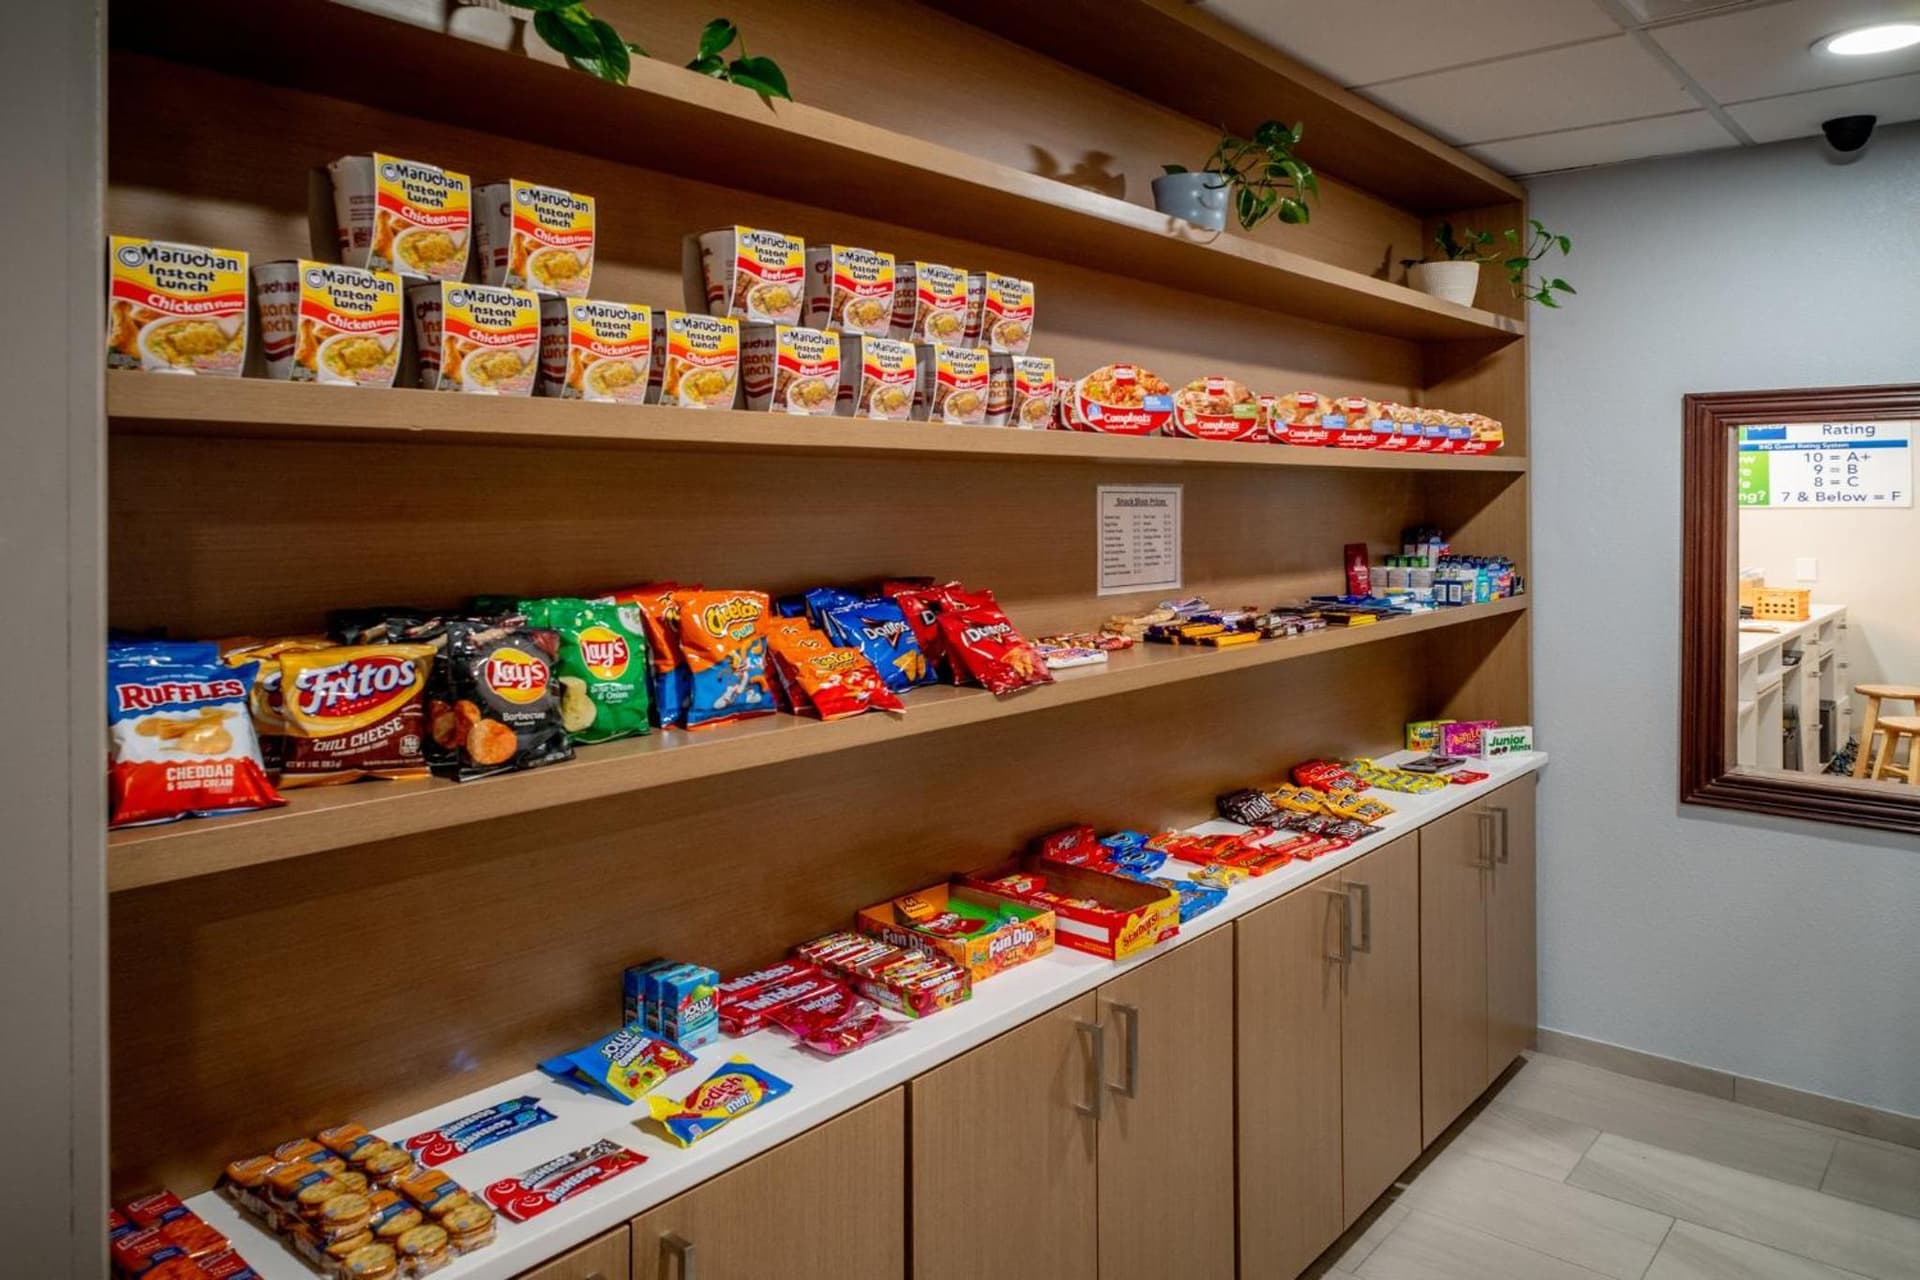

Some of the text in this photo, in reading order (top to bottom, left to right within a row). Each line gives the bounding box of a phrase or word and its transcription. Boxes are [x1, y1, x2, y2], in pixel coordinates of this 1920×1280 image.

[396, 164, 463, 191] Maruchan
[402, 180, 448, 198] Instant
[407, 191, 444, 208] Lunch
[529, 189, 588, 212] Maruchan
[401, 206, 447, 225] Chicken
[534, 204, 575, 220] Instant
[539, 214, 571, 228] Lunch
[535, 228, 574, 244] Chicken
[751, 234, 800, 251] Maruchan
[141, 247, 238, 271] Maruchan
[759, 255, 785, 266] Lunch
[845, 252, 890, 267] Maruchan
[149, 265, 215, 281] Instant
[322, 269, 394, 293] Maruchan
[853, 271, 877, 281] Lunch
[156, 278, 208, 292] Lunch
[328, 286, 378, 302] Instant
[464, 289, 532, 308] Maruchan
[148, 294, 213, 313] Chicken
[333, 298, 372, 312] Lunch
[469, 304, 516, 317] Instant
[327, 313, 376, 330] Chicken
[475, 315, 512, 327] Lunch
[586, 306, 645, 321] Maruchan
[591, 319, 631, 330] Instant
[683, 318, 734, 334] Maruchan
[469, 329, 515, 344] Chicken
[596, 329, 628, 339] Lunch
[687, 331, 722, 342] Instant
[790, 332, 835, 345] Maruchan
[591, 341, 630, 353] Chicken
[691, 340, 718, 350] Lunch
[686, 353, 719, 364] Chicken
[1103, 413, 1151, 424] Compleats
[1198, 420, 1239, 431] Compleats
[1288, 430, 1328, 440] Compleats
[1822, 424, 1876, 438] Rating
[1804, 452, 1823, 462] 10
[1847, 452, 1871, 462] A+
[1814, 464, 1823, 474] 9
[1848, 464, 1858, 474] B
[1814, 477, 1823, 487] 8
[1847, 476, 1859, 487] C
[1782, 492, 1791, 502] 7
[1797, 491, 1809, 501] &
[1815, 491, 1867, 502] Below
[1892, 491, 1901, 501] F
[705, 599, 759, 635] Cheetos
[864, 620, 911, 640] Doritos
[968, 623, 1011, 642] Doritos
[584, 640, 624, 667] Lay's
[493, 659, 547, 689] Lay's
[119, 680, 244, 710] RUFFLES
[296, 661, 416, 715] Fritos
[606, 690, 629, 700] Onion
[502, 711, 546, 721] Barbecue
[313, 739, 347, 752] CHILI
[349, 717, 404, 747] CHEESE
[1489, 734, 1526, 747] Junior
[1510, 743, 1531, 752] Mints
[166, 764, 235, 781] CHEDDAR
[203, 777, 234, 788] CREAM
[882, 928, 933, 956] Fun Dip
[989, 928, 1034, 959] Fun Dip
[684, 996, 713, 1018] JOLLY
[601, 1030, 633, 1059] JOLLY
[455, 1119, 513, 1153] AIRHEADS
[519, 1155, 577, 1190] AIRHEADS
[546, 1166, 601, 1202] AIRHEADS
